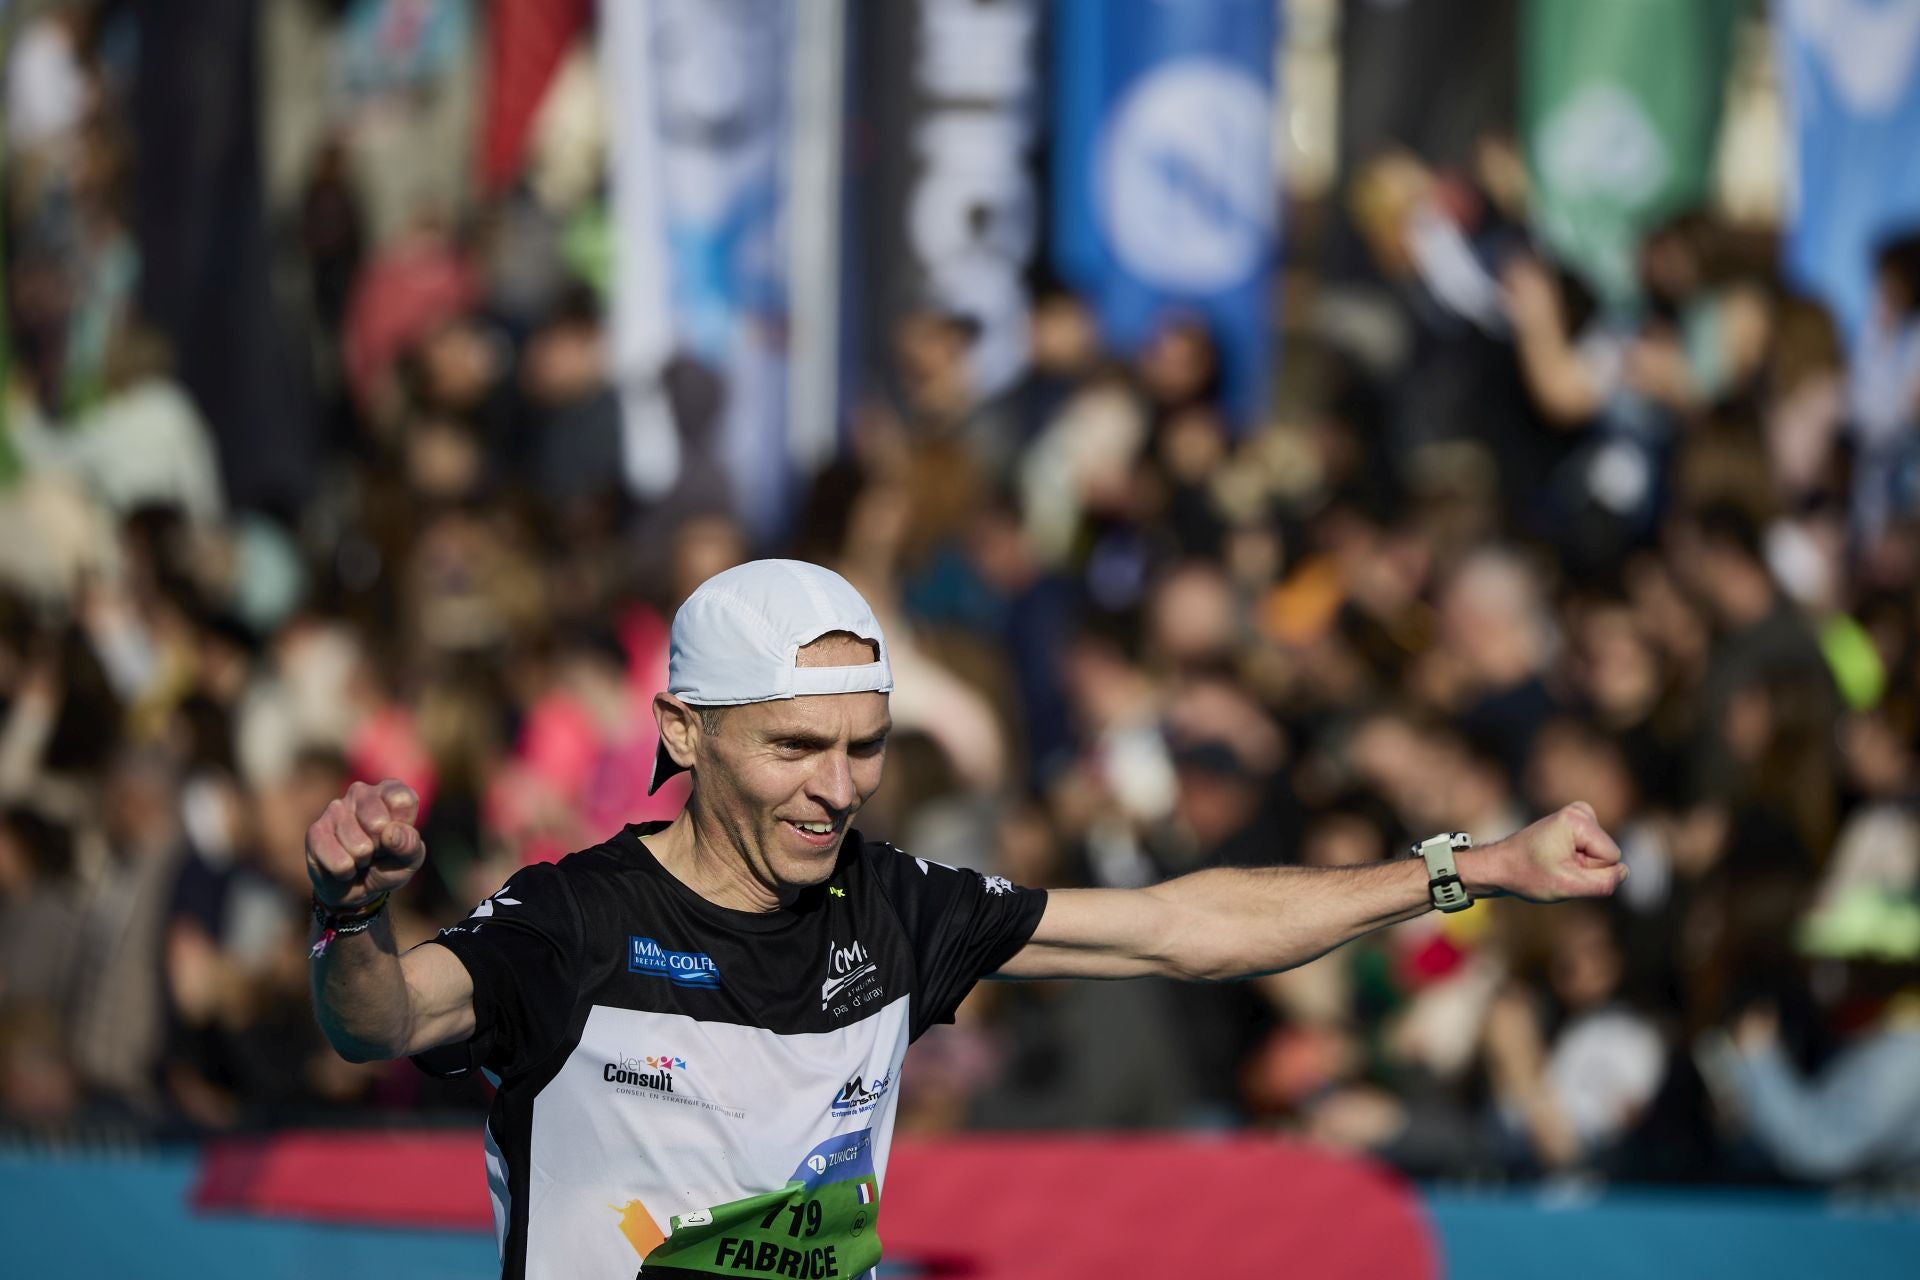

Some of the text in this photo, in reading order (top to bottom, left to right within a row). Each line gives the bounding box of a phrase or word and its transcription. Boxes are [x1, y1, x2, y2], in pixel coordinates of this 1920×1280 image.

[669, 955, 717, 971] GOLFE
[619, 1052, 642, 1072] ker
[603, 1063, 674, 1093] Consult
[616, 1087, 646, 1098] CONSEIL
[649, 1093, 659, 1101] EN
[829, 1146, 858, 1167] ZURICH
[760, 1199, 822, 1238] 719
[714, 1237, 839, 1280] FABRICE
